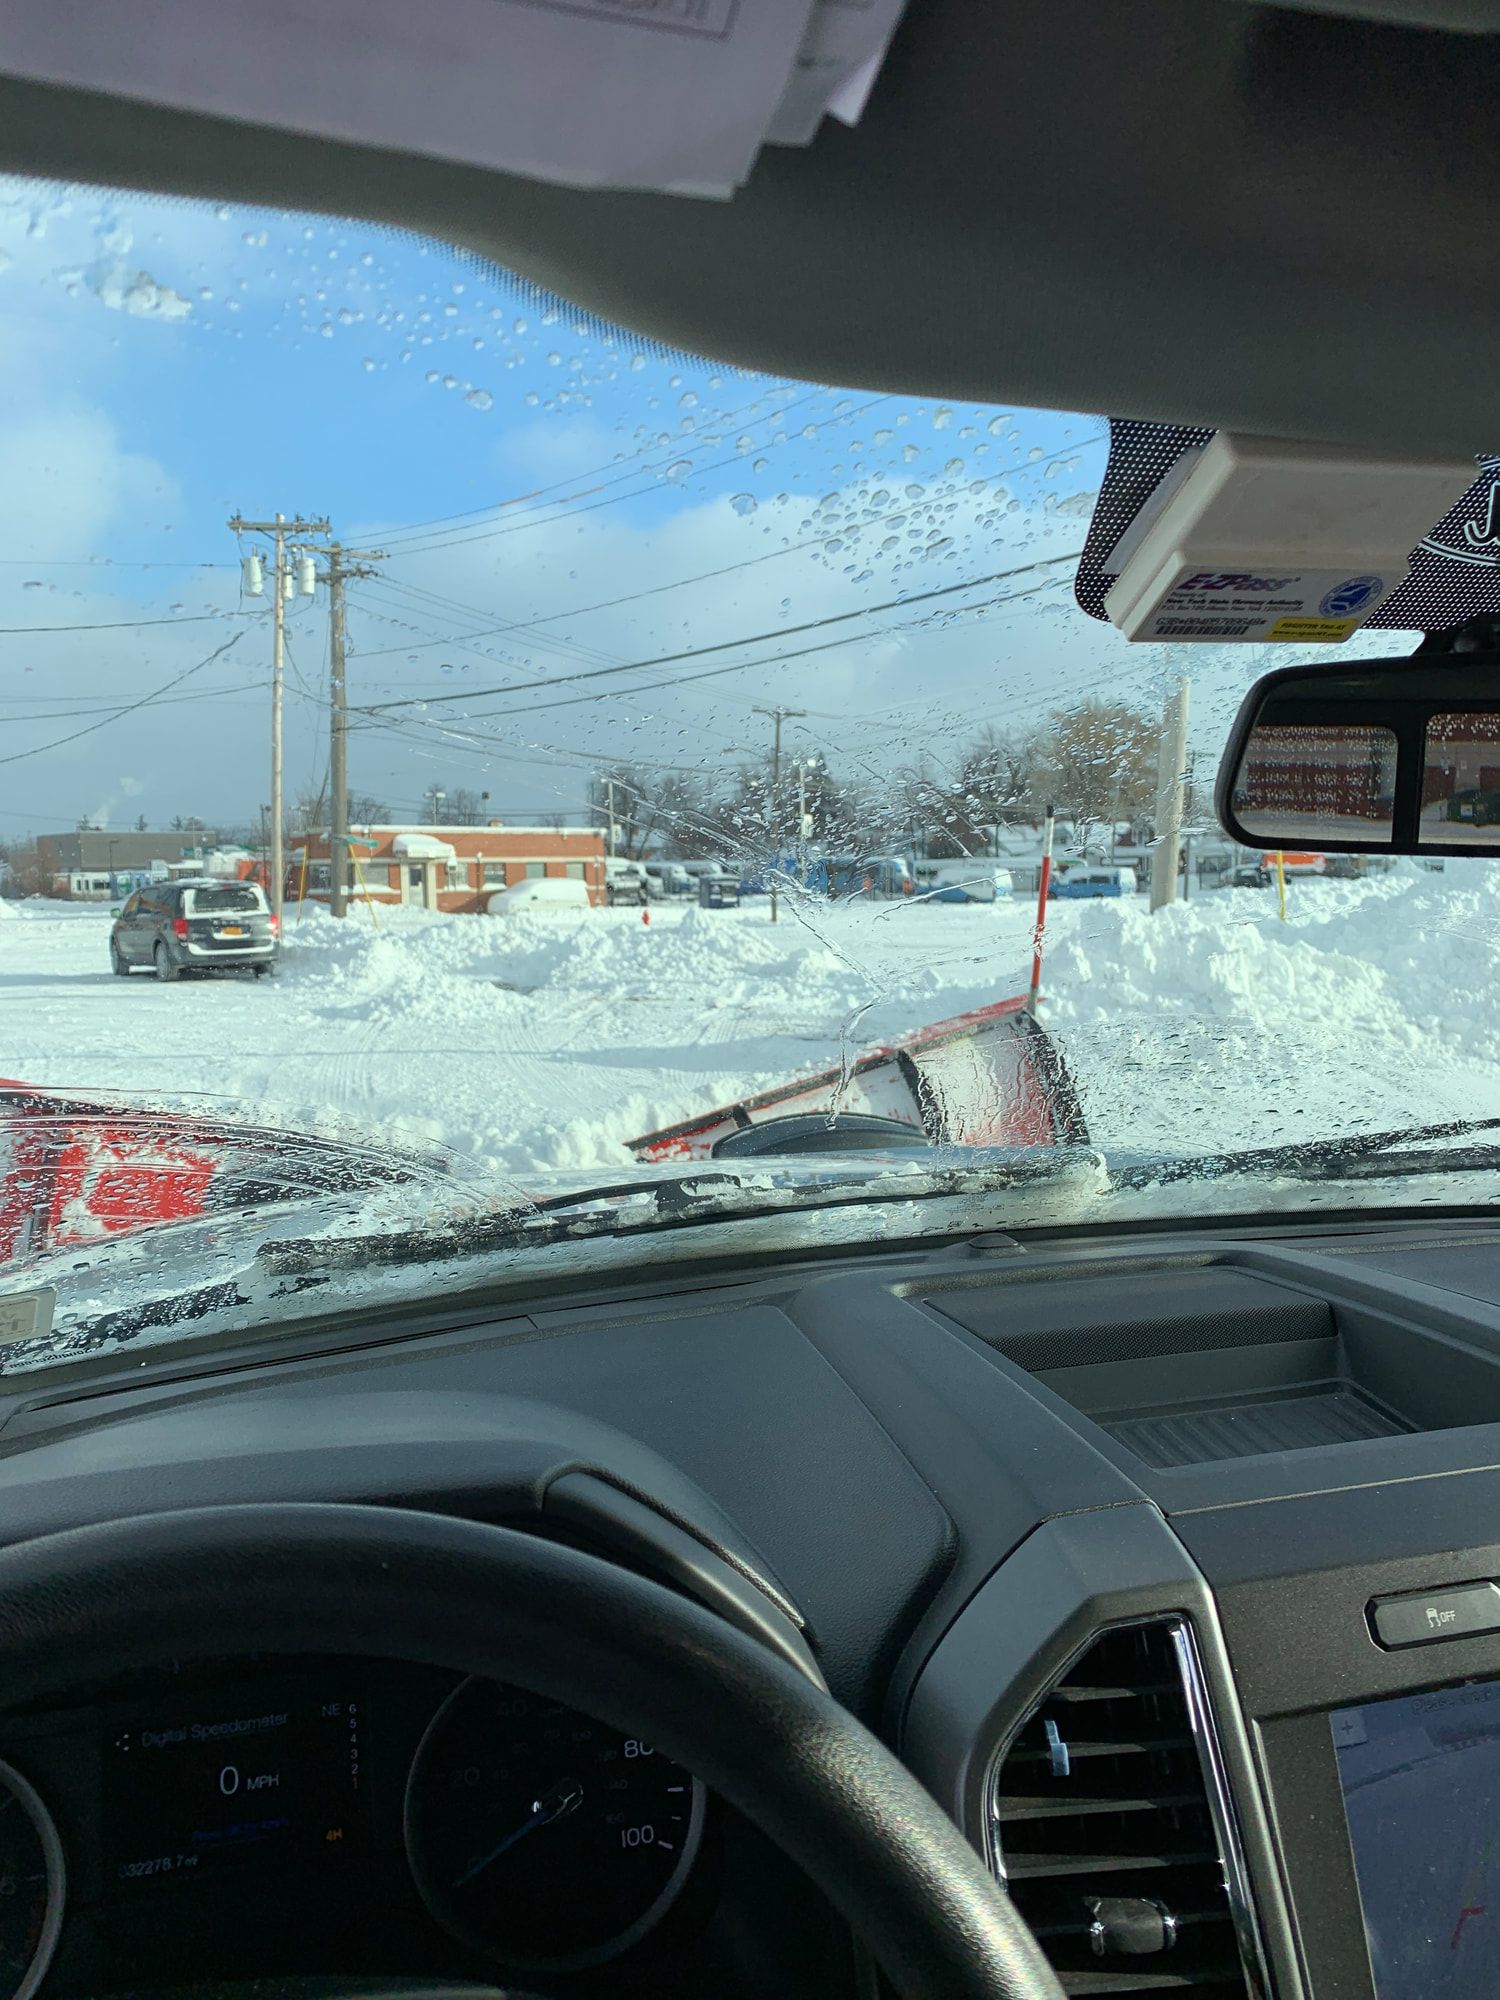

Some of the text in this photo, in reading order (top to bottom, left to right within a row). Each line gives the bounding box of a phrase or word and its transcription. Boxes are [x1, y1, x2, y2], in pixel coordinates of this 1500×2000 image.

[1440, 1610, 1456, 1623] OFF
[321, 1703, 341, 1717] NE
[348, 1703, 357, 1714] 6
[140, 1712, 289, 1748] Digital Speedometer
[349, 1718, 357, 1729] 5
[349, 1733, 358, 1744] 4
[350, 1748, 358, 1760] 3
[624, 1739, 654, 1758] 80
[351, 1763, 359, 1775] 2
[220, 1765, 280, 1795] 0 MPH
[324, 1827, 344, 1841] 4H
[621, 1825, 655, 1848] 100
